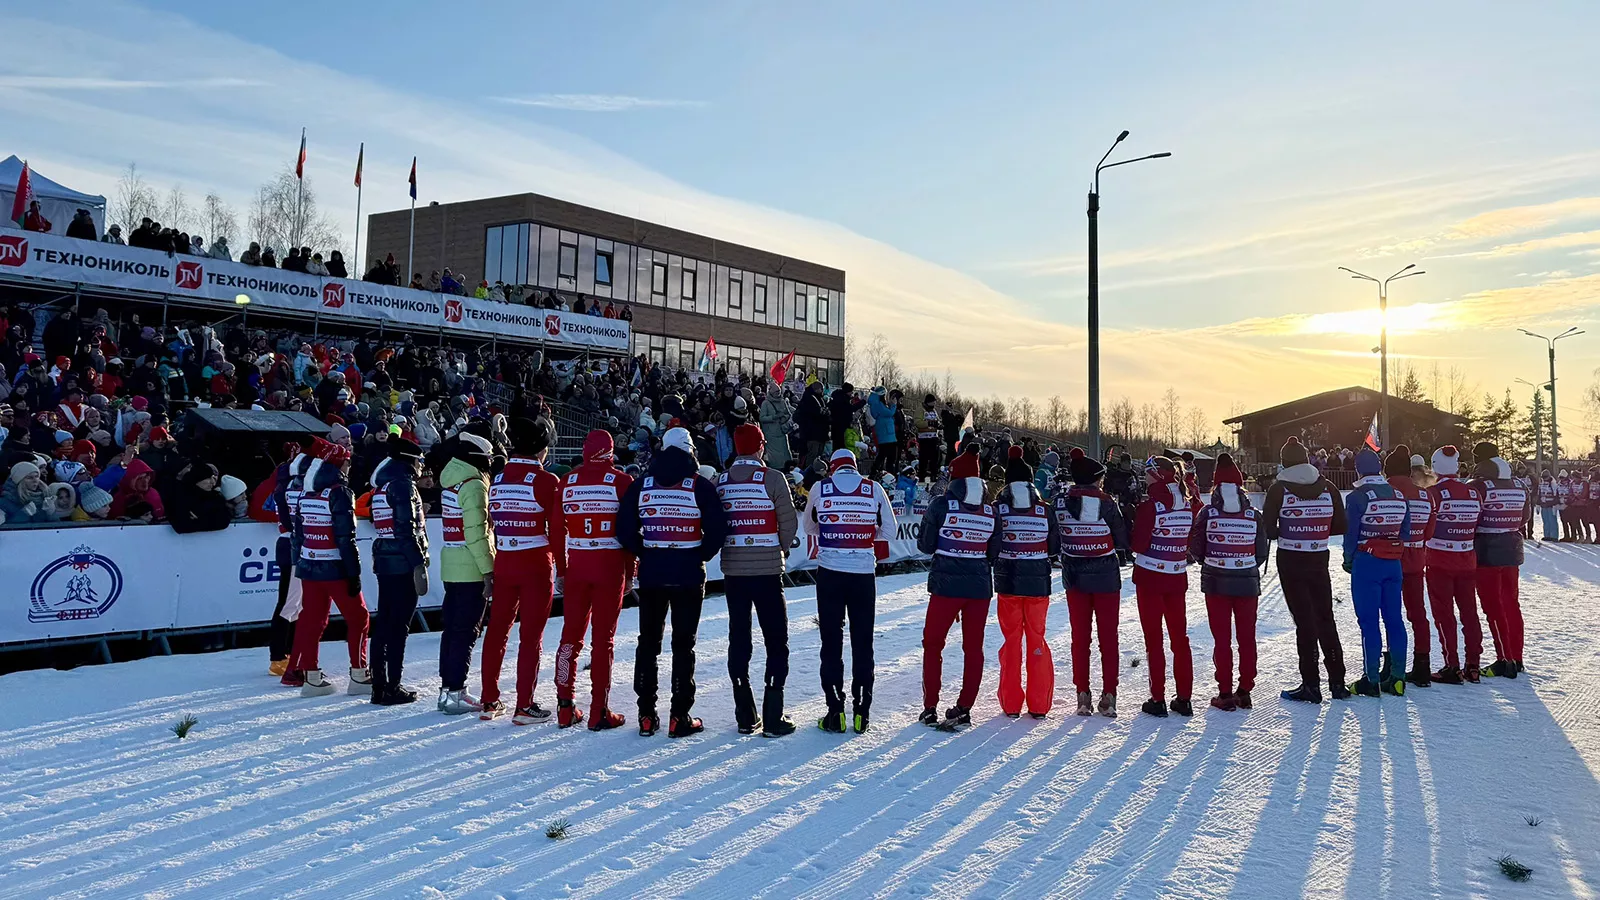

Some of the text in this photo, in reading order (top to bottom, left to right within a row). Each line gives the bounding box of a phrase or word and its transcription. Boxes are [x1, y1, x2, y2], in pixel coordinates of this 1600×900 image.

[33, 248, 170, 278] ТЕХНОНИКОЛЬ
[207, 271, 318, 298] ТЕХНОНИКОЛЬ
[348, 292, 440, 314] ТЕХНОНИКОЛЬ
[465, 309, 541, 328] ТЕХНОНИКОЛЬ
[562, 322, 627, 339] ТЕХНОНИКОЛЬ
[584, 518, 592, 535] 5
[1288, 525, 1329, 533] МАЛЬЦЕВ
[822, 532, 872, 540] ЧЕРВОТКИН
